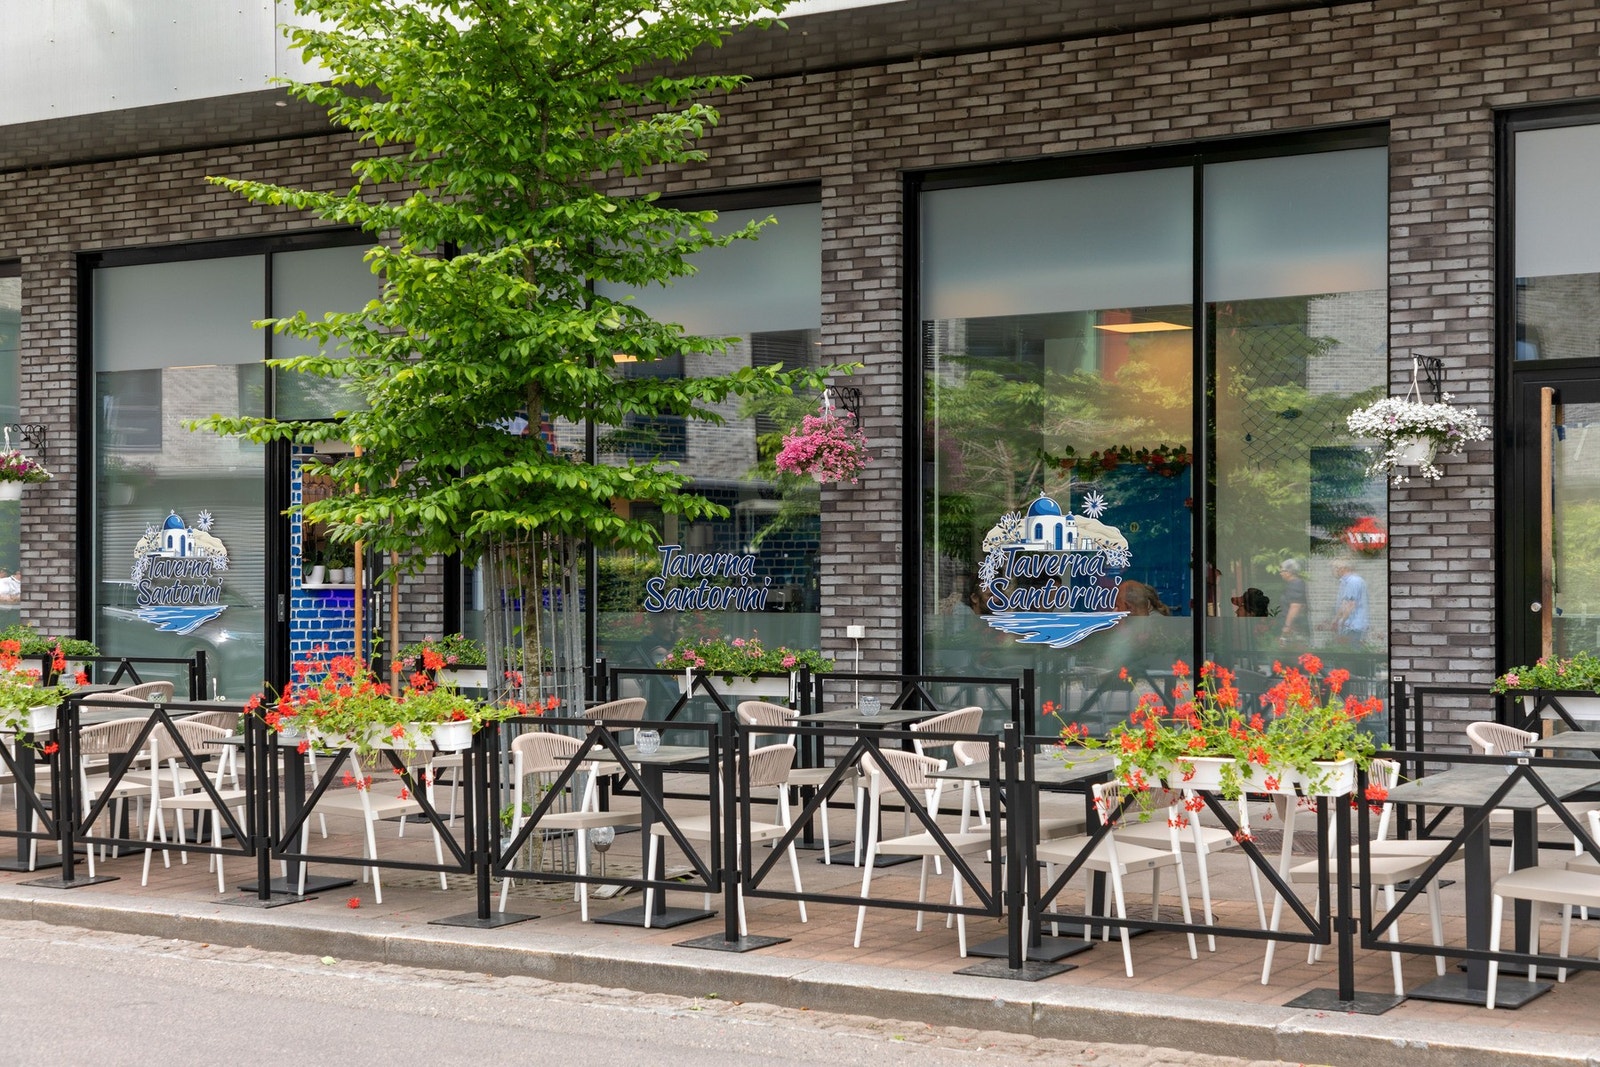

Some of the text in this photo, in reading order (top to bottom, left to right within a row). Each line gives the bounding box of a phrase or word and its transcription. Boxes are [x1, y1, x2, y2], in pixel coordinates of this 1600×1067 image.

[146, 553, 213, 579] Taverna
[658, 545, 756, 578] Taverna
[1002, 547, 1106, 579] Taverna
[137, 577, 223, 605] Santorini
[644, 577, 771, 612] Santorini
[986, 576, 1122, 611] Santorini
